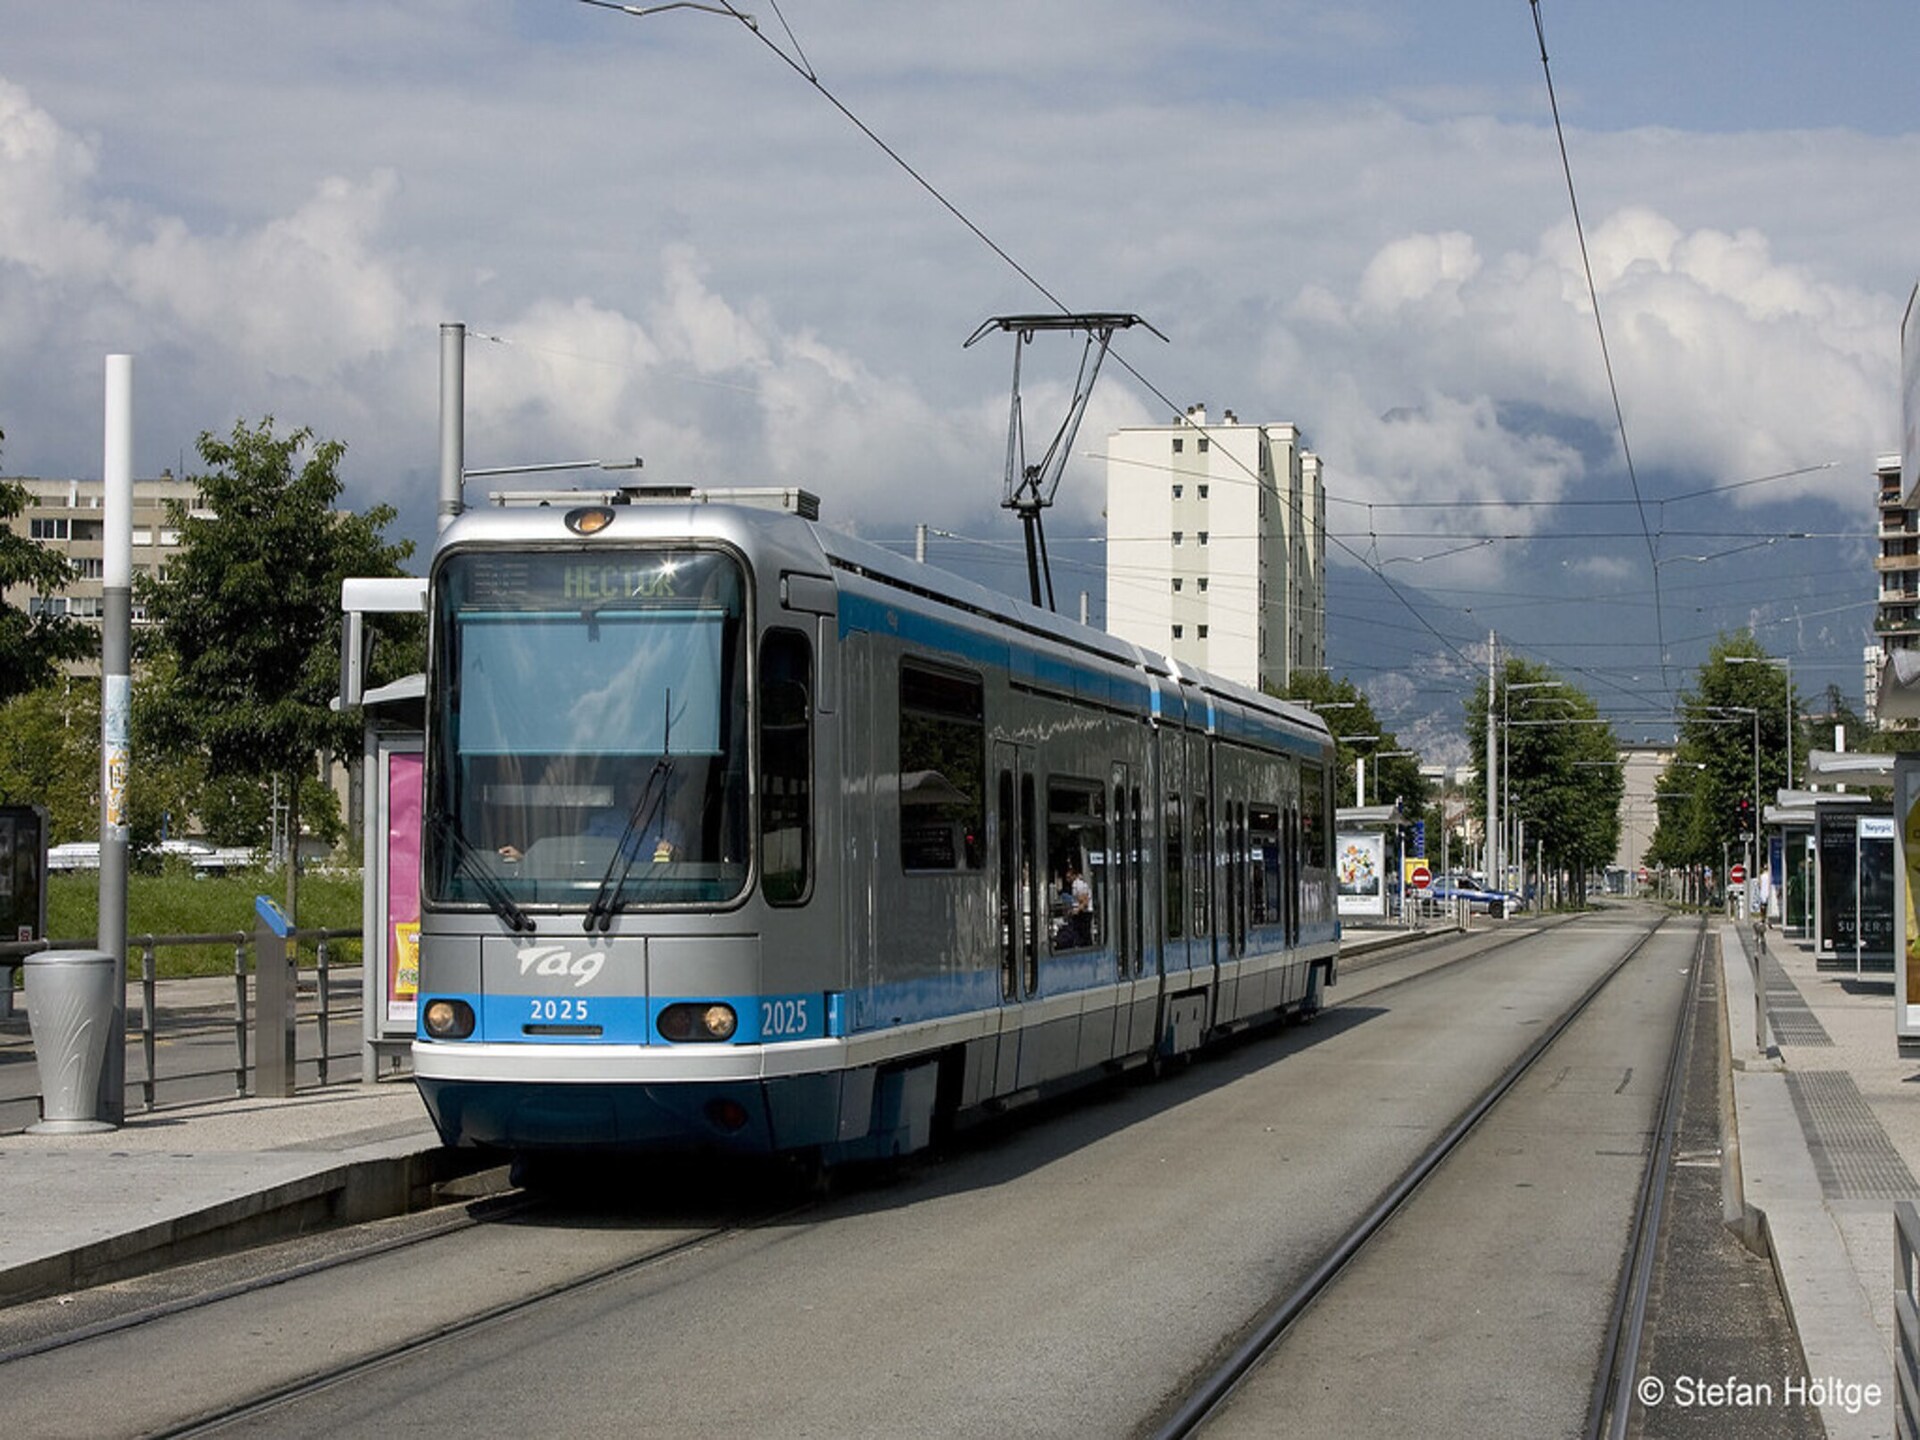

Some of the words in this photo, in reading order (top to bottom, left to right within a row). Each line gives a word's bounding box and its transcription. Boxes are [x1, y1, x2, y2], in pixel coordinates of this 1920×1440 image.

[1838, 920, 1881, 932] SUER
[530, 1000, 588, 1020] 2025
[761, 999, 808, 1036] 2025
